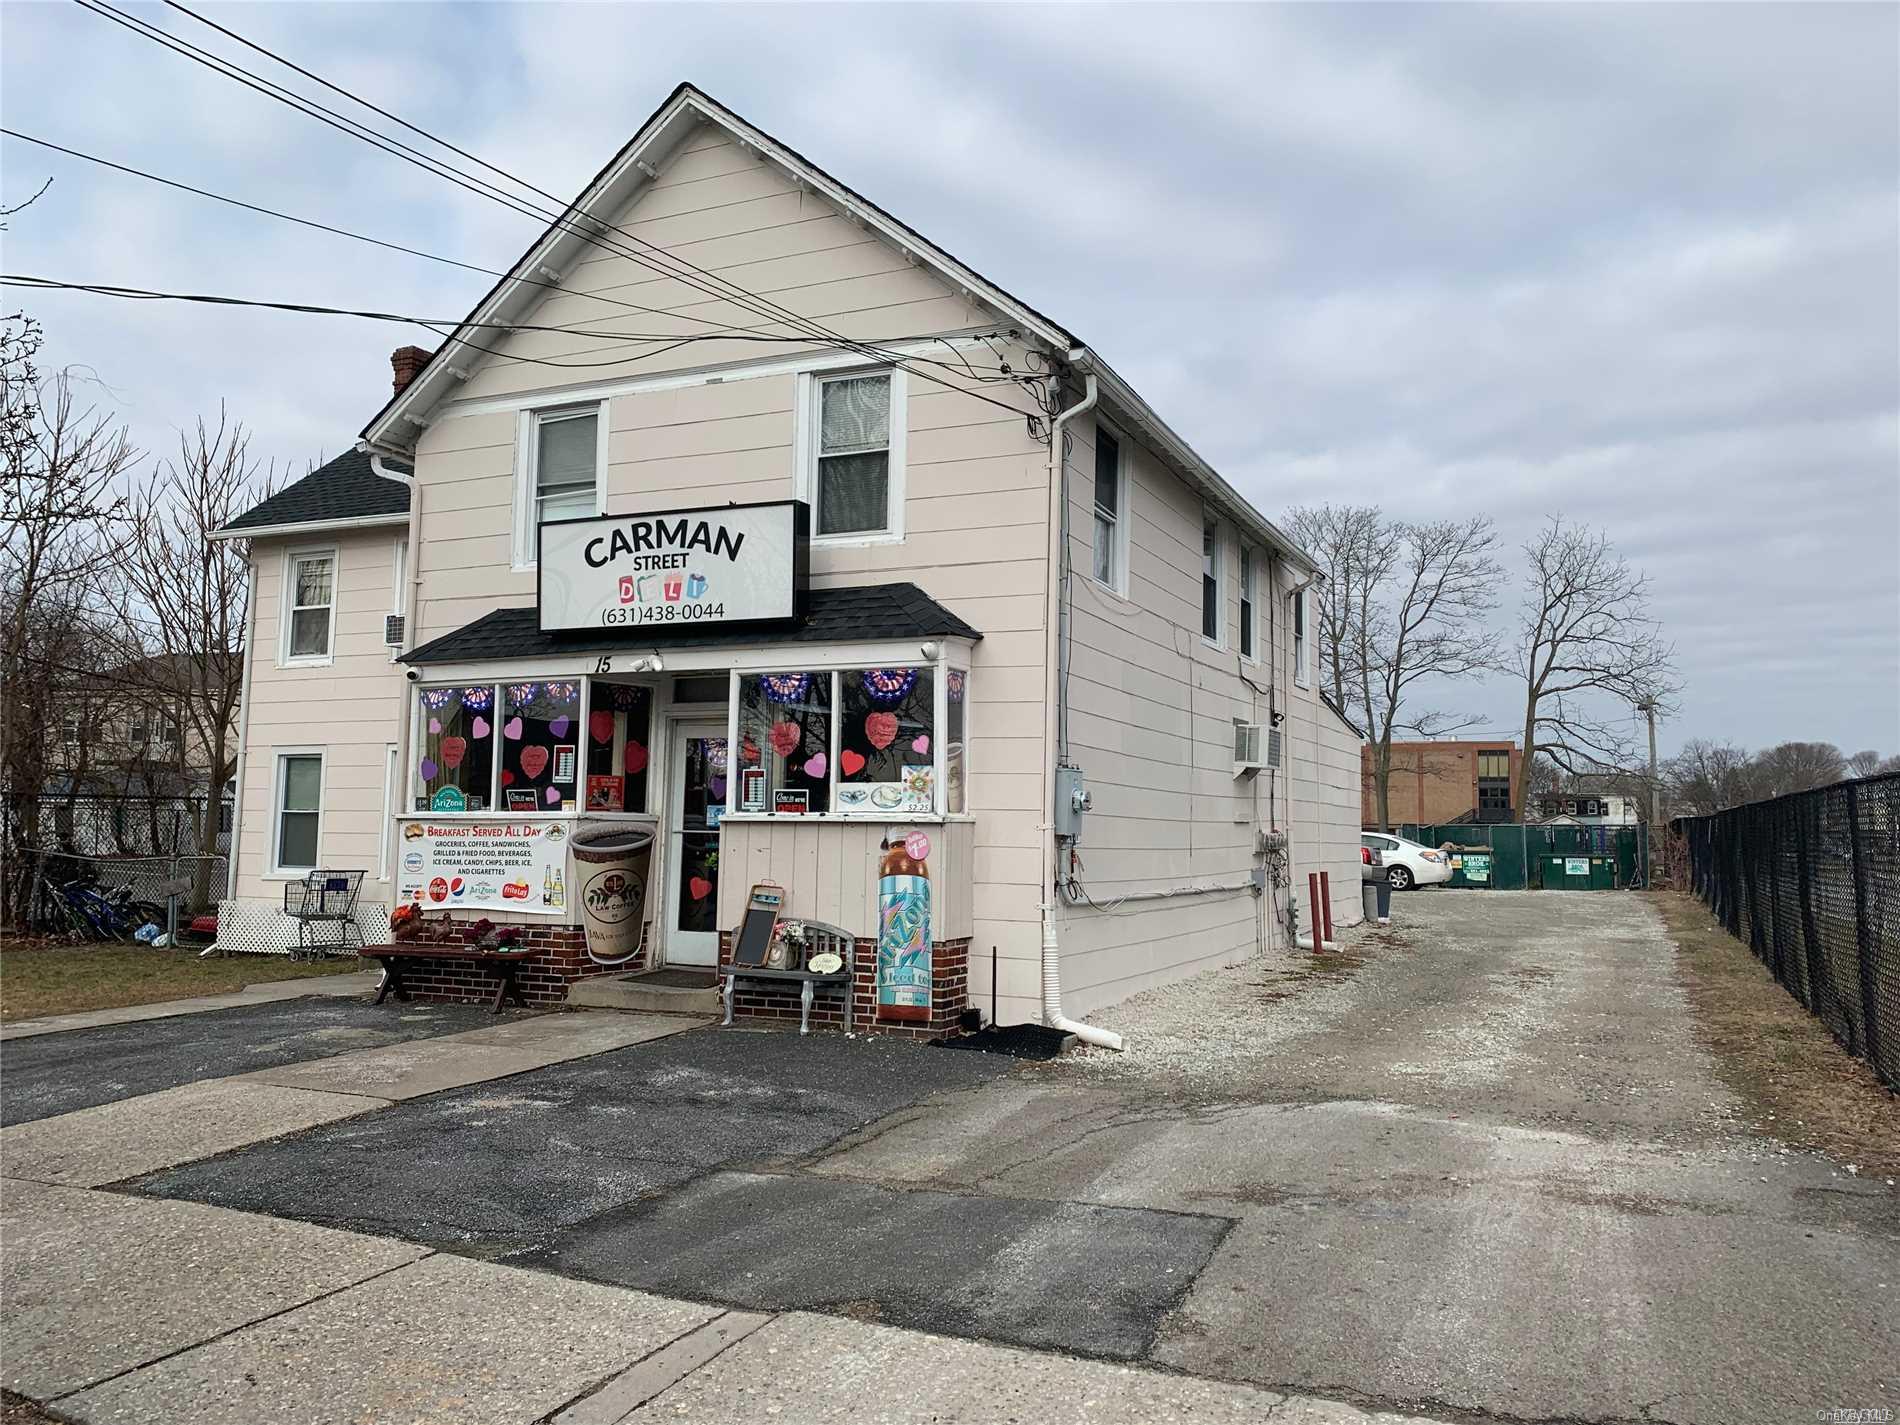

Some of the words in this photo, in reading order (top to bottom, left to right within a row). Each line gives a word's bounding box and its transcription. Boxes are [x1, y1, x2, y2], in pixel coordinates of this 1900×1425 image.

[584, 519, 745, 568] CARMAN
[633, 552, 690, 571] STREET
[601, 603, 725, 625] (631)438-0044
[595, 656, 612, 673] 15
[427, 826, 471, 837] BREAKFAST
[472, 826, 502, 837] SERVED
[504, 826, 520, 837] ALL
[523, 826, 542, 837] DAY
[470, 886, 497, 895] AriZona
